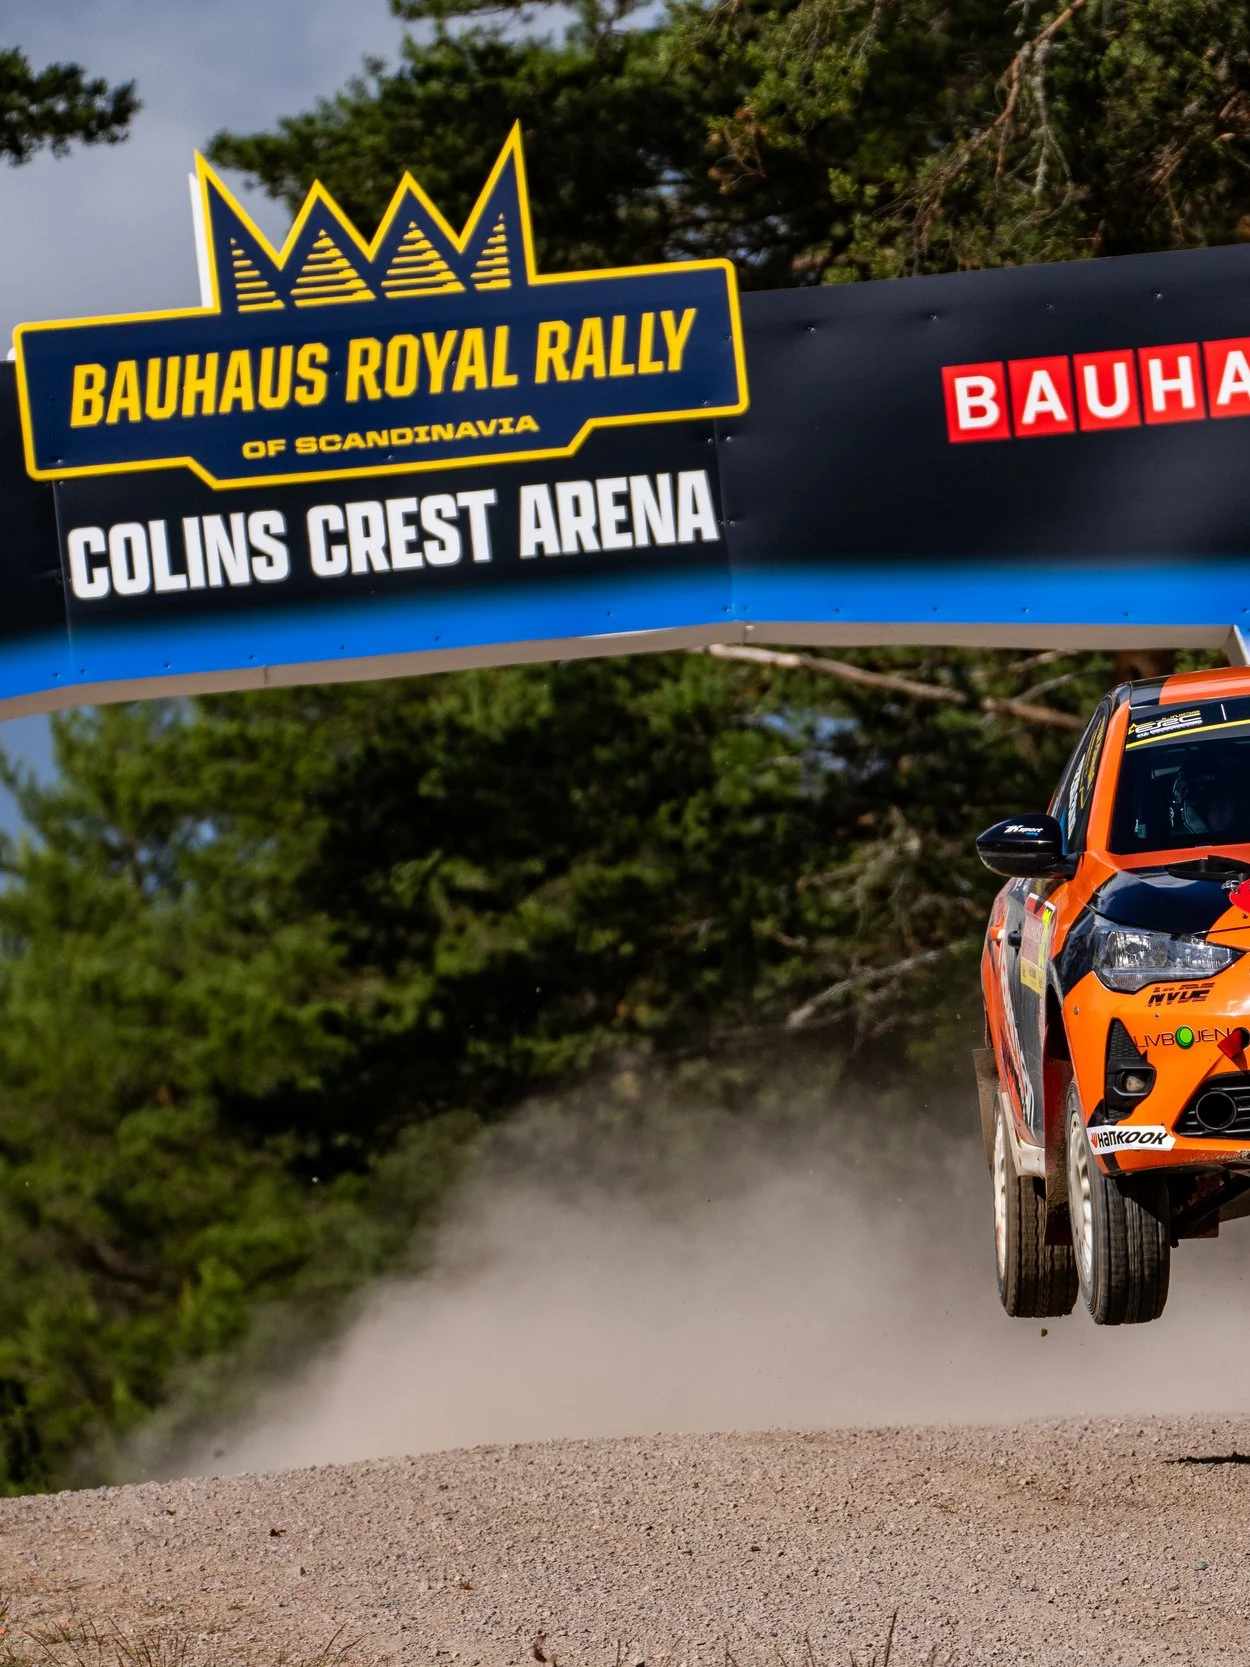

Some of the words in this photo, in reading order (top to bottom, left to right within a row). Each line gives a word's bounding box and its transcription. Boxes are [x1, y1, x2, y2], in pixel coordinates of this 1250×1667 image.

[70, 342, 329, 428] BAUHAUS
[345, 325, 518, 402] ROYAL
[534, 308, 697, 384] RALLY
[242, 438, 287, 460] OF
[295, 414, 540, 456] SCANDINAVIA
[67, 509, 291, 600] COLINS
[306, 489, 499, 577] CREST
[518, 469, 720, 560] ARENA
